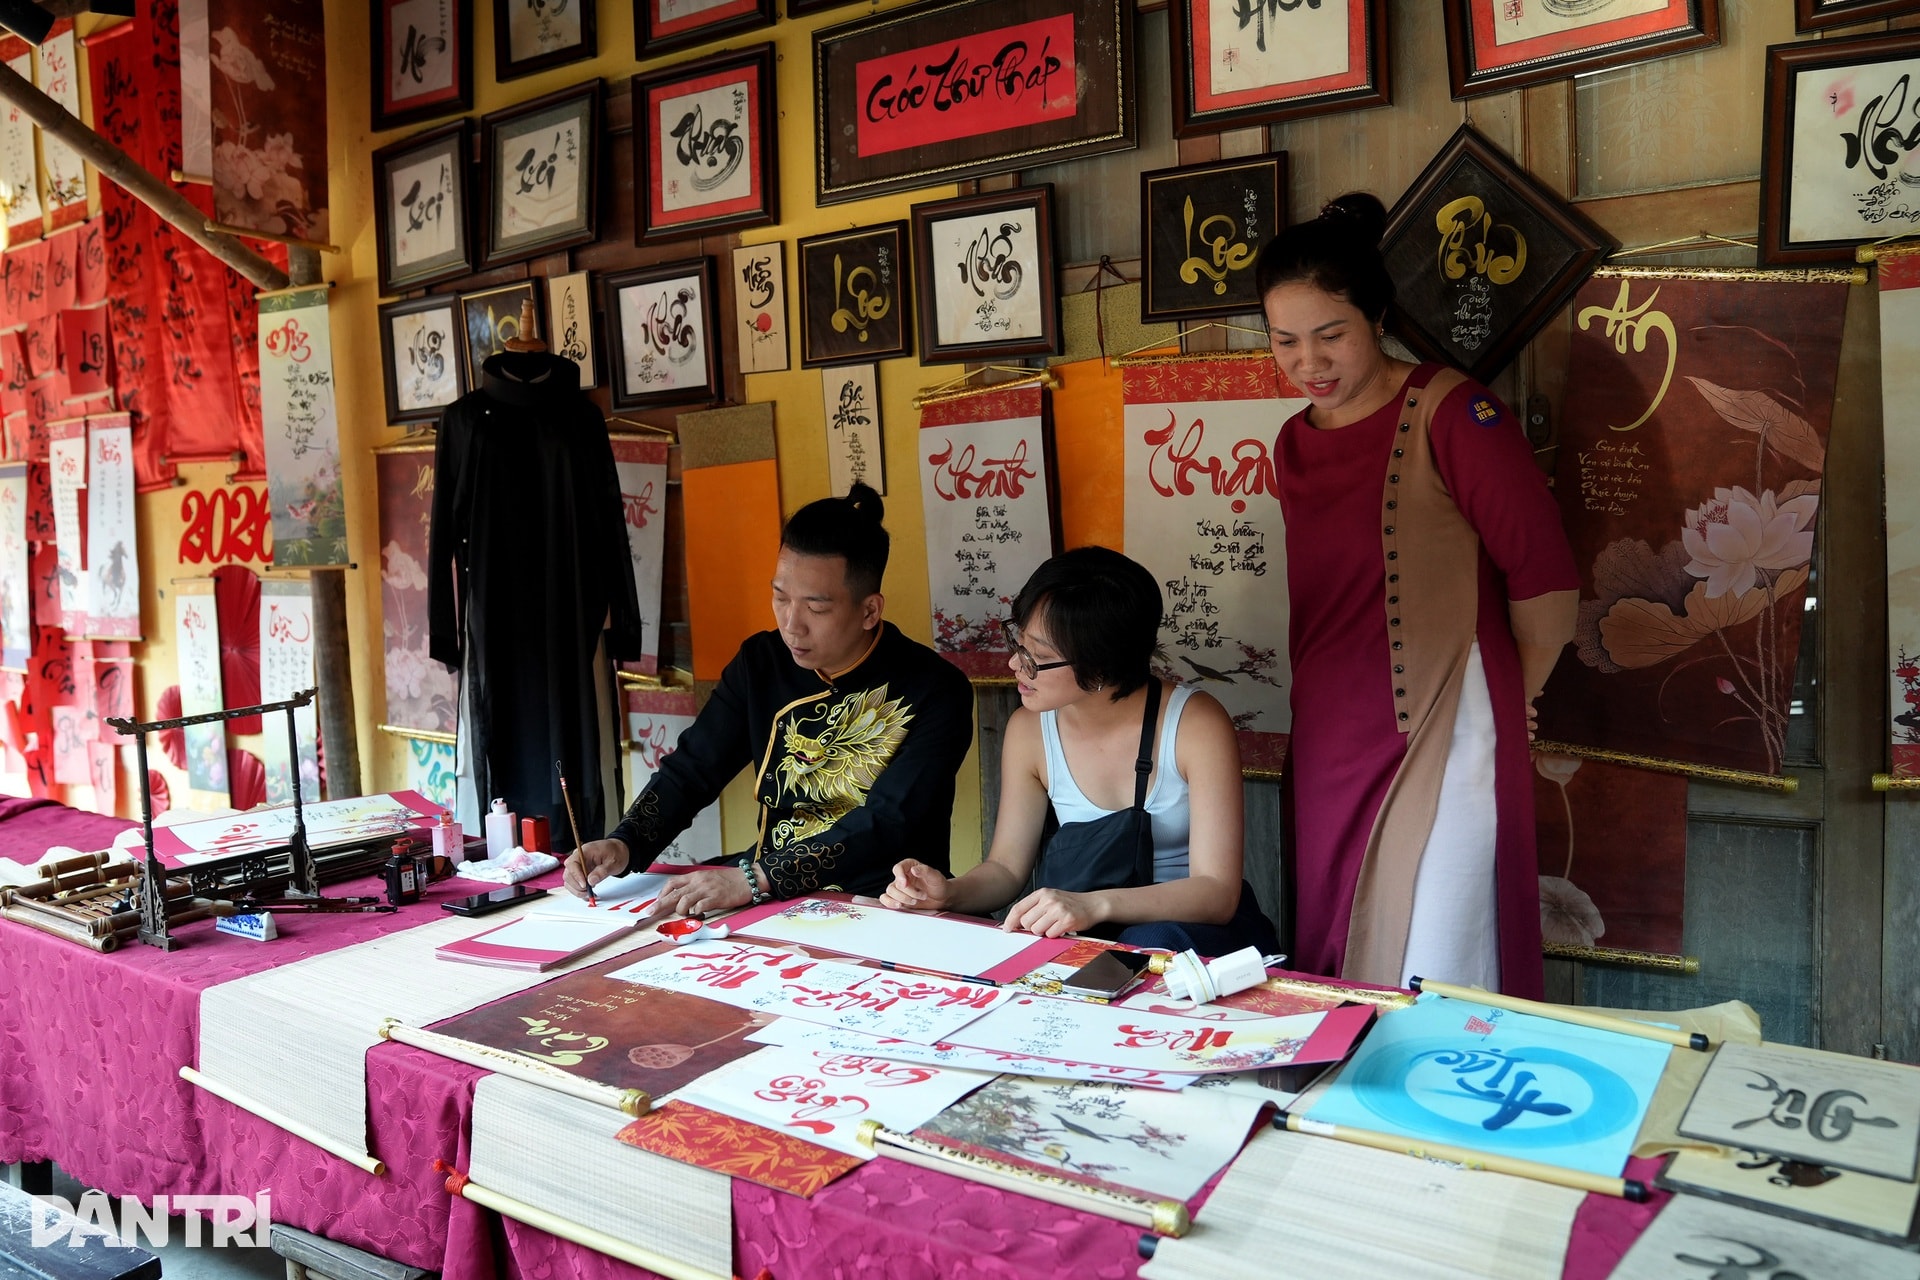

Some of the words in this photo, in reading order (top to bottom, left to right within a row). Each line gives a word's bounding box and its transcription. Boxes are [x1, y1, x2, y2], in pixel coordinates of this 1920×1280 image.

[866, 65, 932, 123] Góc
[992, 36, 1061, 109] Pháp
[1180, 194, 1259, 295] Lộc
[831, 253, 891, 343] Lộc
[1143, 408, 1280, 514] Thuận
